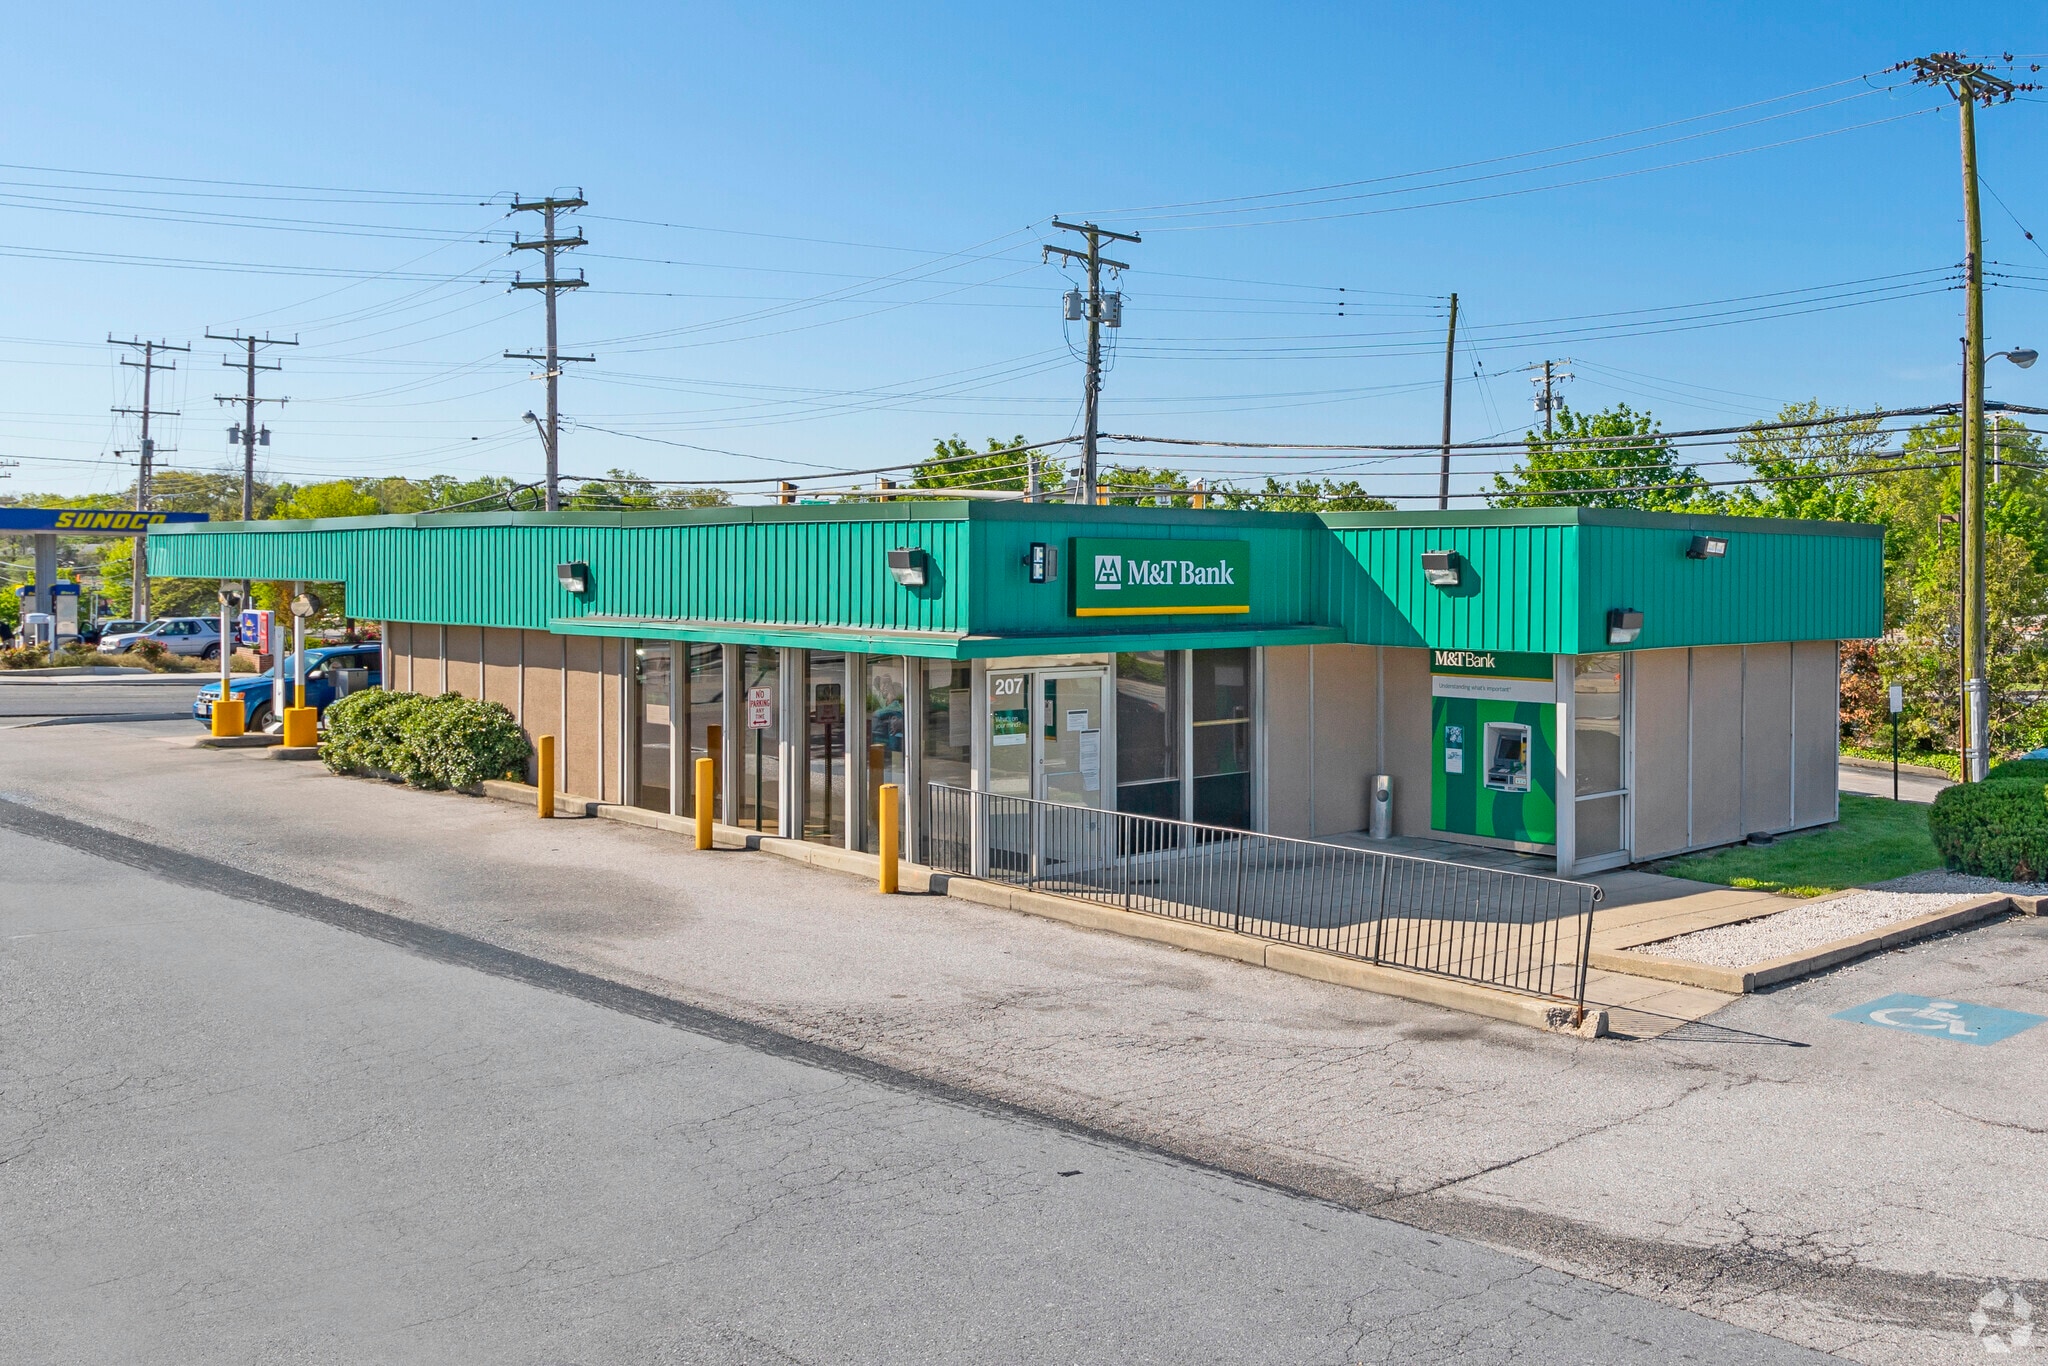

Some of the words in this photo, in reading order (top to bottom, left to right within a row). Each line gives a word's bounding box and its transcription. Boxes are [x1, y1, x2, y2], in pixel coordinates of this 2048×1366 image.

[1127, 560, 1177, 585] M&T
[1179, 560, 1234, 585] Bank
[1435, 651, 1465, 667] M&T
[1465, 652, 1496, 668] Bank
[995, 678, 1024, 695] 207
[1438, 683, 1471, 691] Understanding
[755, 691, 765, 699] NO
[750, 699, 770, 708] PARKING
